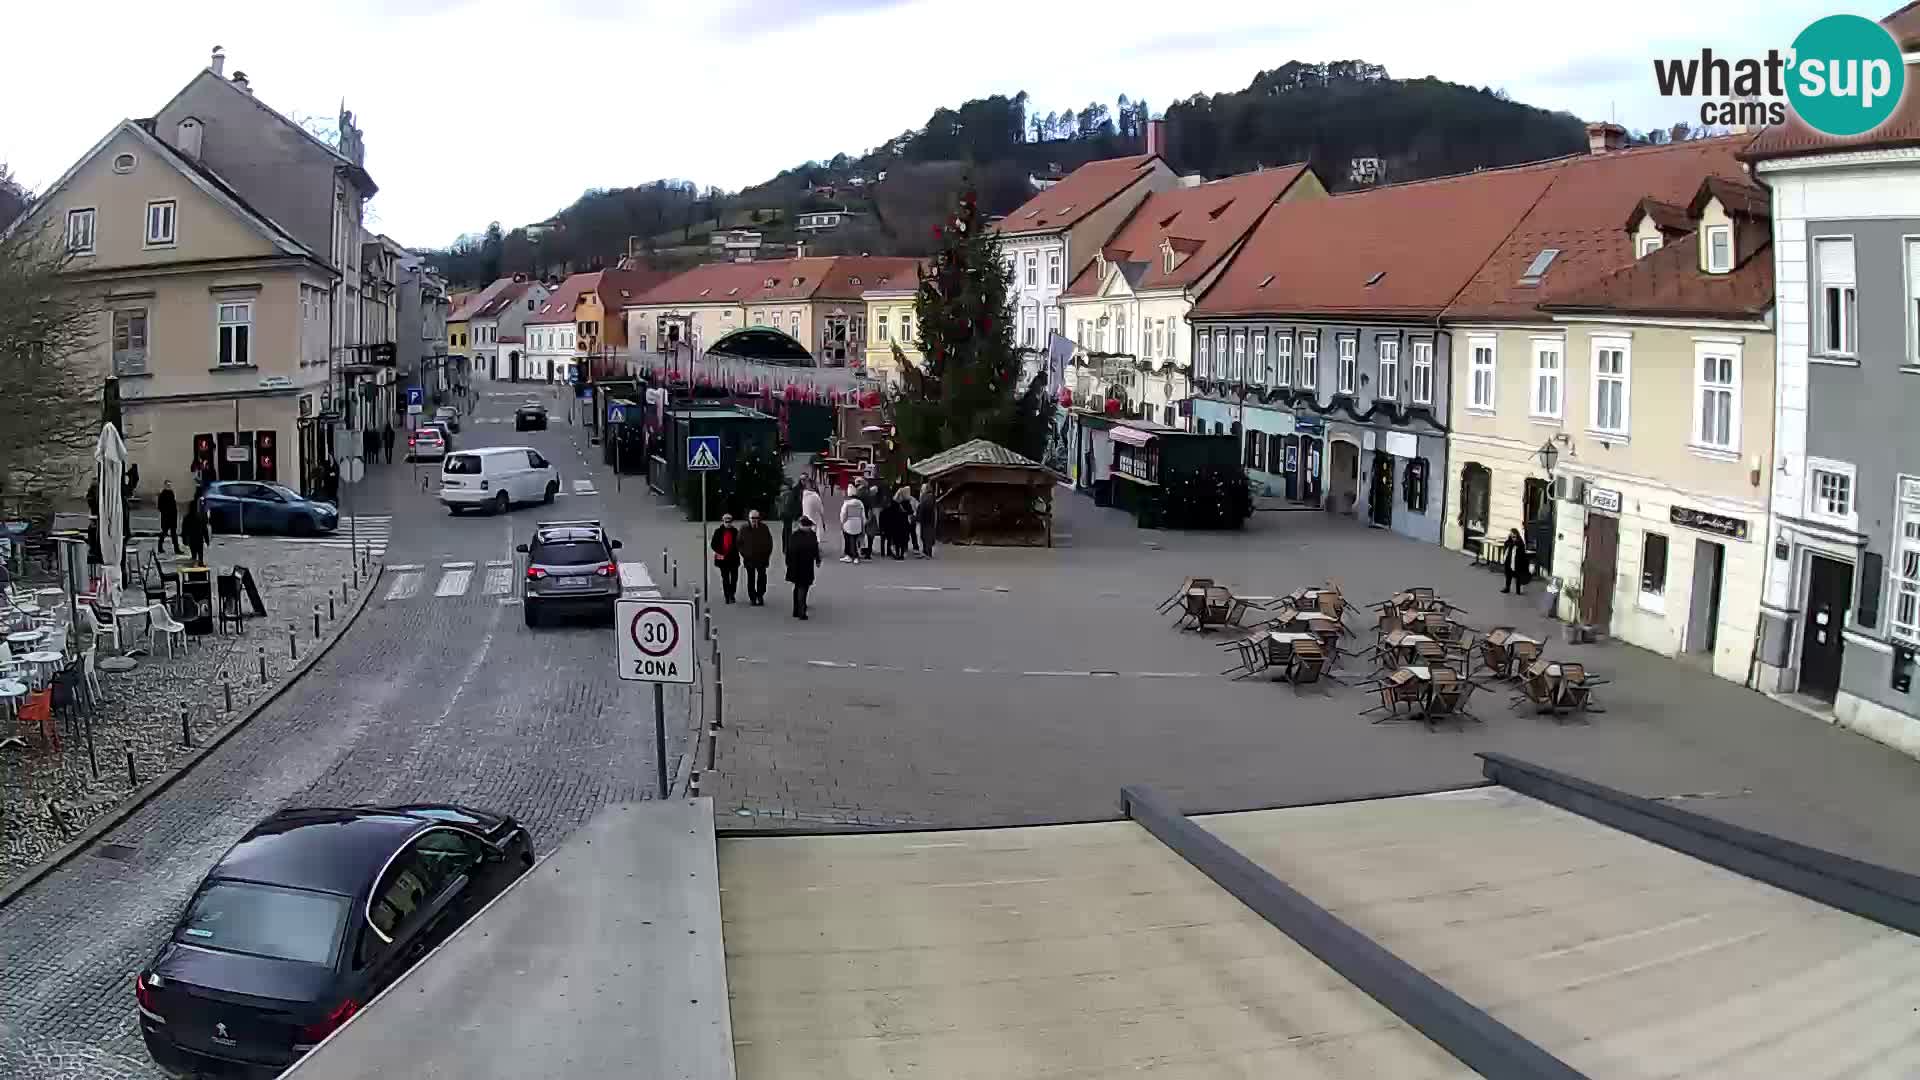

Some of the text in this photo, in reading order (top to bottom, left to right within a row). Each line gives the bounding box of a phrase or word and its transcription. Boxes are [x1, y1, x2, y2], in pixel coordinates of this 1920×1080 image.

[411, 392, 420, 404] P
[643, 622, 668, 644] 30
[634, 659, 678, 677] ZONA
